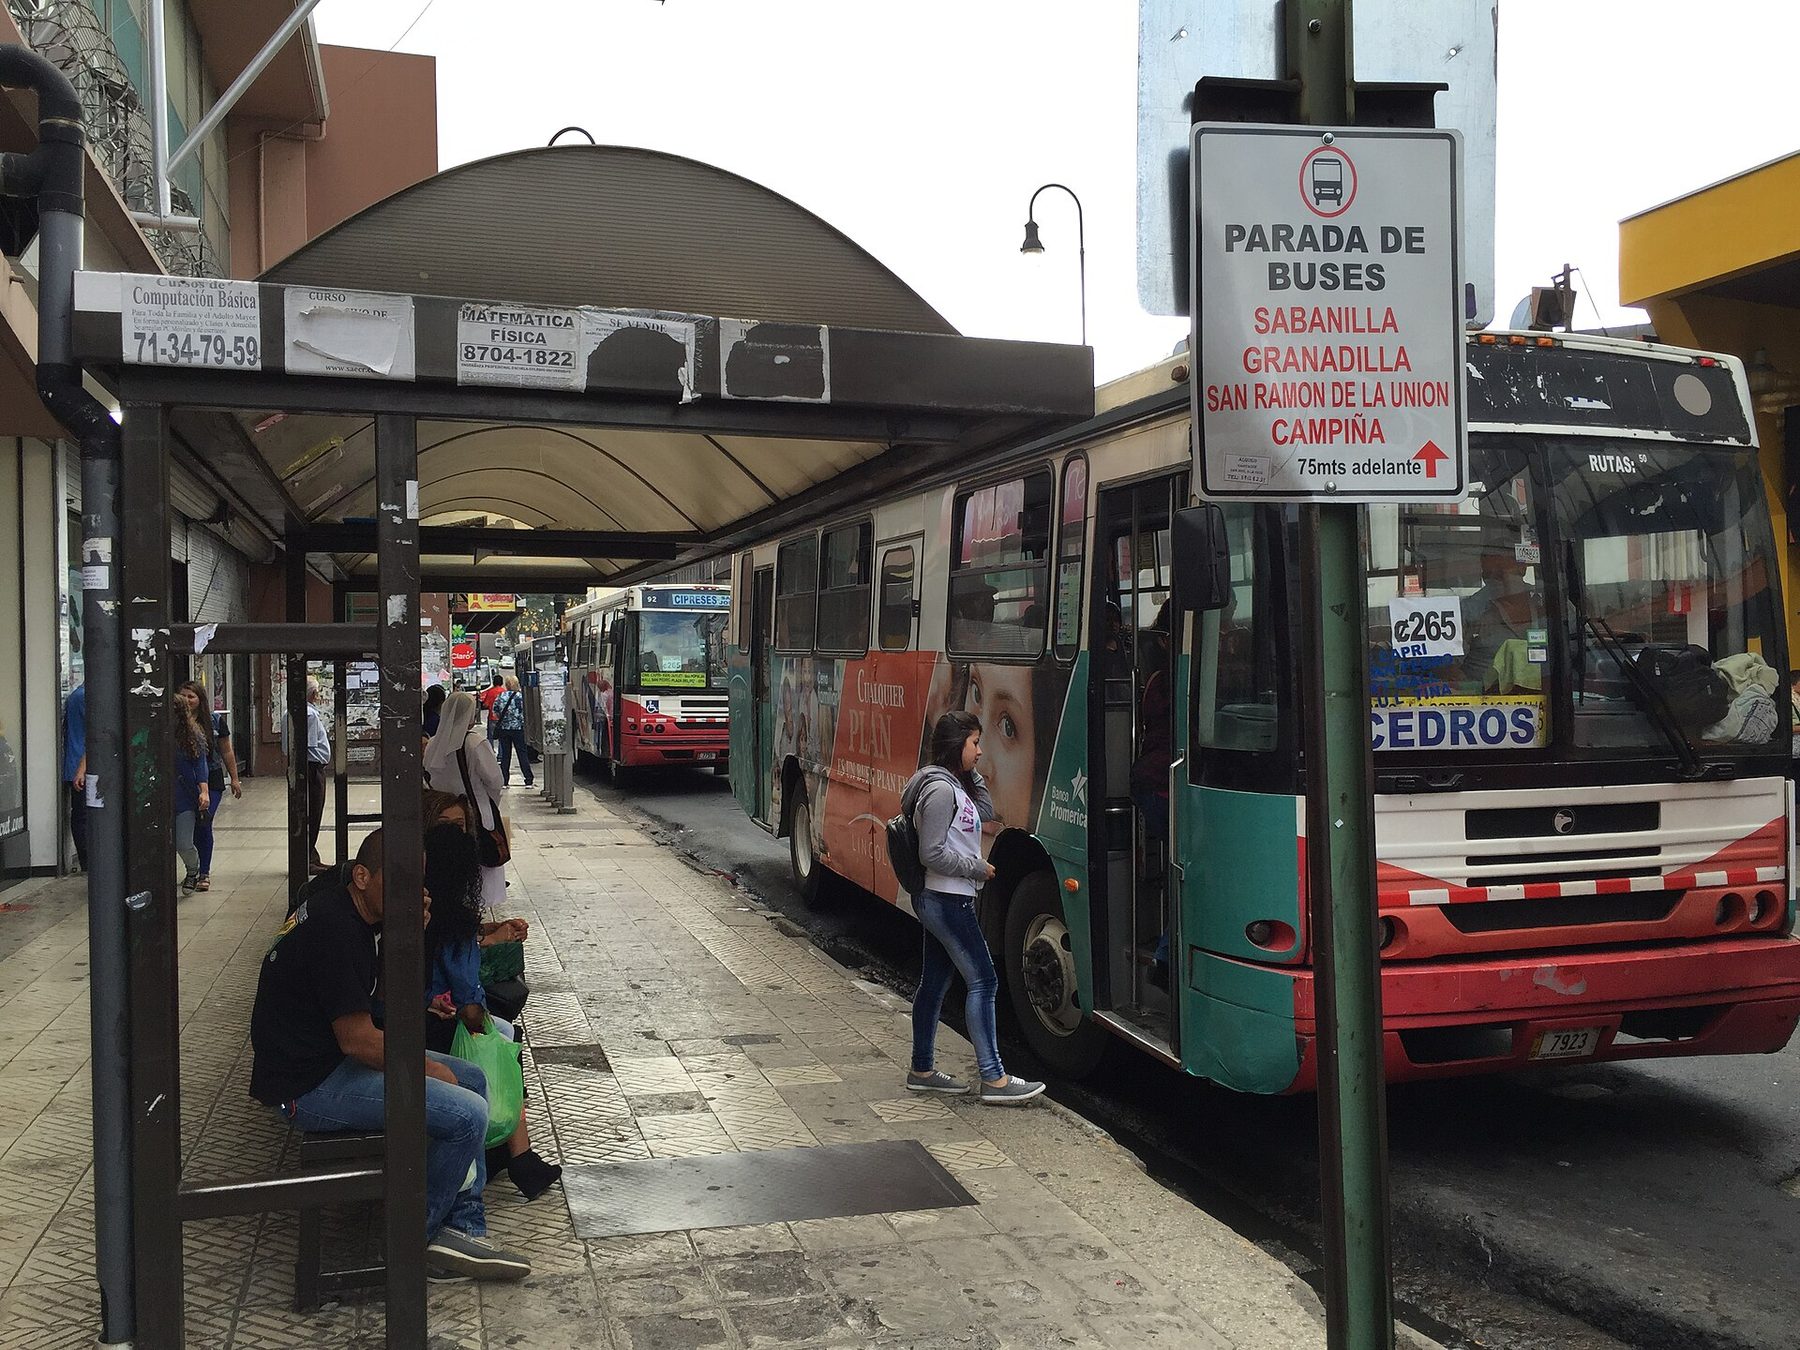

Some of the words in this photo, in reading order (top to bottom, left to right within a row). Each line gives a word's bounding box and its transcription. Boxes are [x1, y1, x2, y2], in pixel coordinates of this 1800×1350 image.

[1225, 224, 1369, 254] PARADA
[1380, 225, 1426, 254] DE
[209, 280, 226, 290] de
[1268, 261, 1386, 291] BUSES
[132, 286, 214, 310] Computación
[218, 290, 257, 309] Básica
[308, 291, 347, 303] CURSO
[461, 308, 575, 328] MATEMATICA
[1253, 306, 1399, 335] SABANILLA
[490, 327, 547, 344] FÍSICA
[133, 331, 259, 367] 71-34-79-59
[463, 345, 573, 367] 8704-1822
[1242, 345, 1412, 374] GRANADILLA
[1207, 383, 1248, 412] SAN
[1254, 381, 1326, 410] RAMON
[1331, 381, 1356, 409] DE
[1362, 381, 1387, 408] LA
[1390, 381, 1449, 408] UNION
[1271, 412, 1386, 446] CAMPIÑA
[1297, 457, 1347, 476] 75mts
[1352, 457, 1422, 476] adelante
[1588, 454, 1636, 474] RUTAS:
[647, 595, 657, 603] 92
[674, 594, 718, 605] CIPRESES
[451, 652, 471, 660] Claro
[857, 668, 905, 709] CUALQUIER
[848, 708, 892, 762] PLAN
[1051, 785, 1070, 802] Banco
[1050, 800, 1088, 828] Promerica
[1550, 1032, 1589, 1052] 7923
